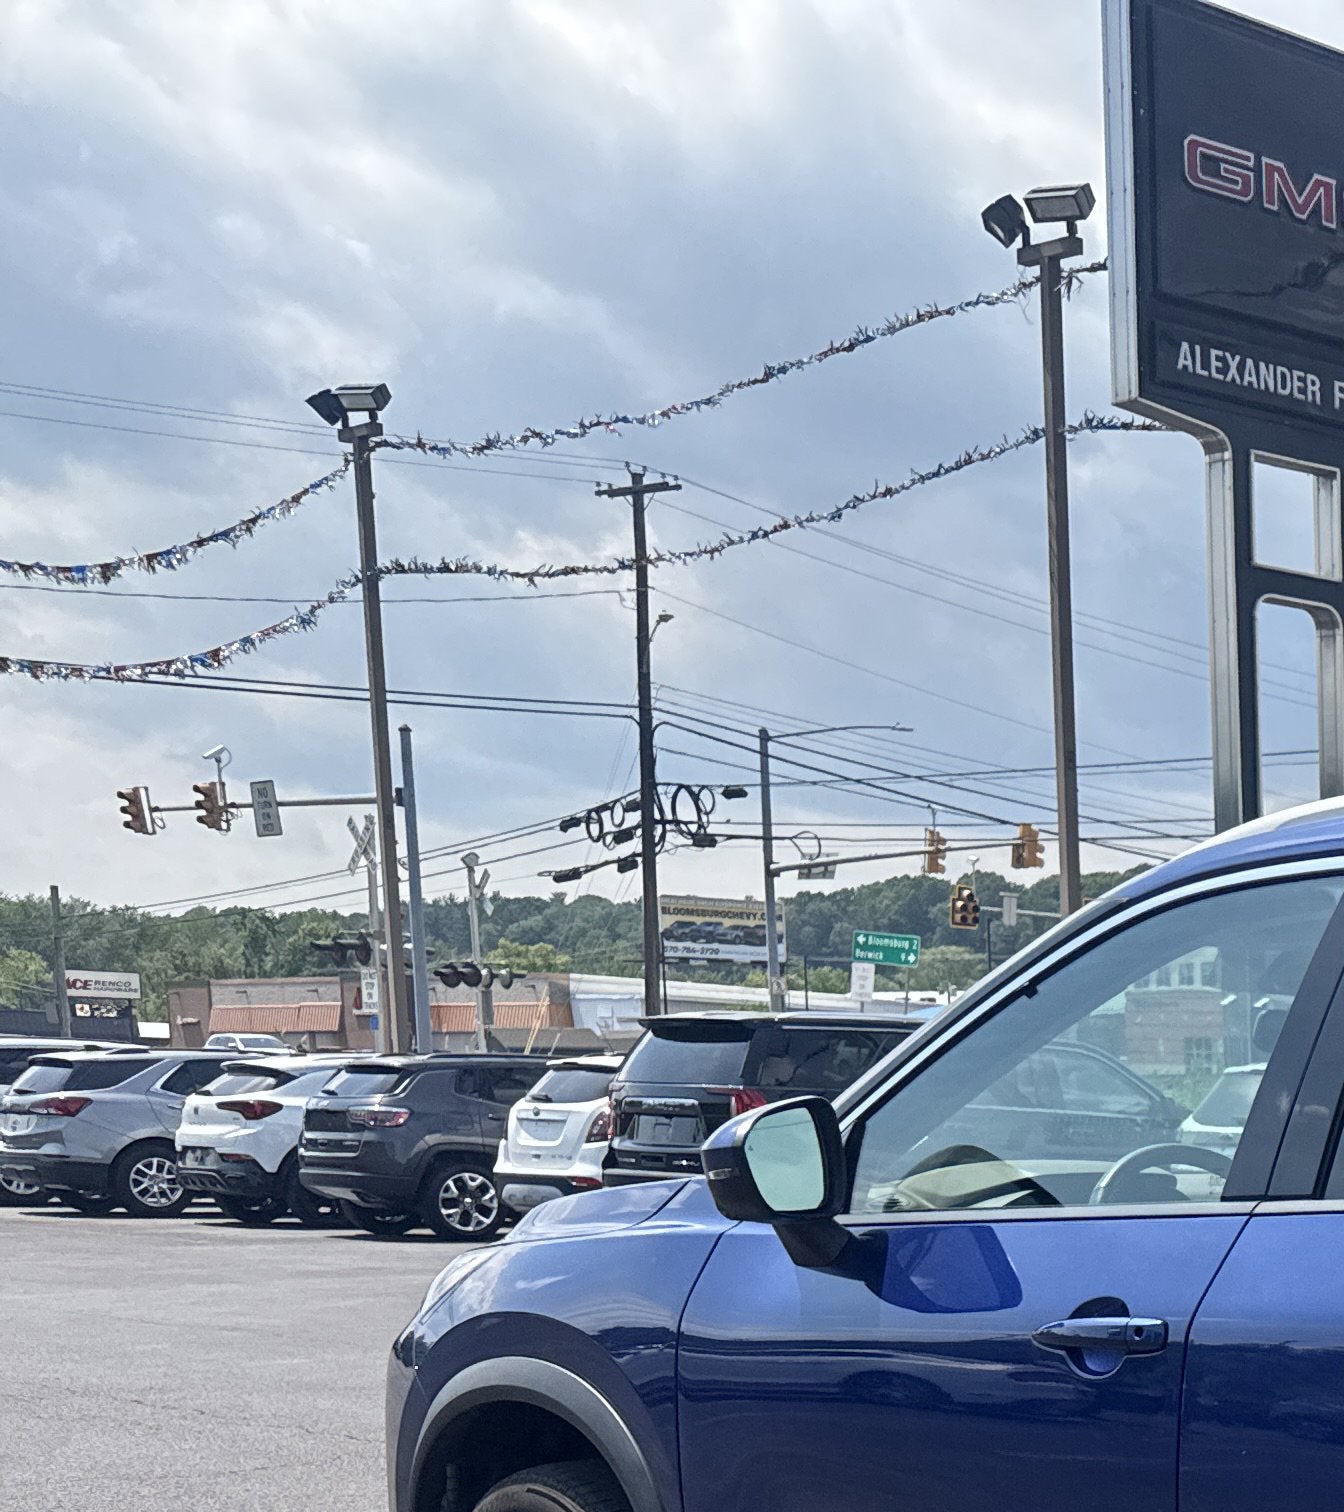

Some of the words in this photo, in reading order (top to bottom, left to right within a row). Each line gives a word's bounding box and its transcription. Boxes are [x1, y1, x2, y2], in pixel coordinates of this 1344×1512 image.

[1177, 341, 1321, 405] ALEXANDER
[257, 787, 268, 799] NO
[867, 935, 910, 950] Bloomsburg
[65, 977, 93, 991] ACE
